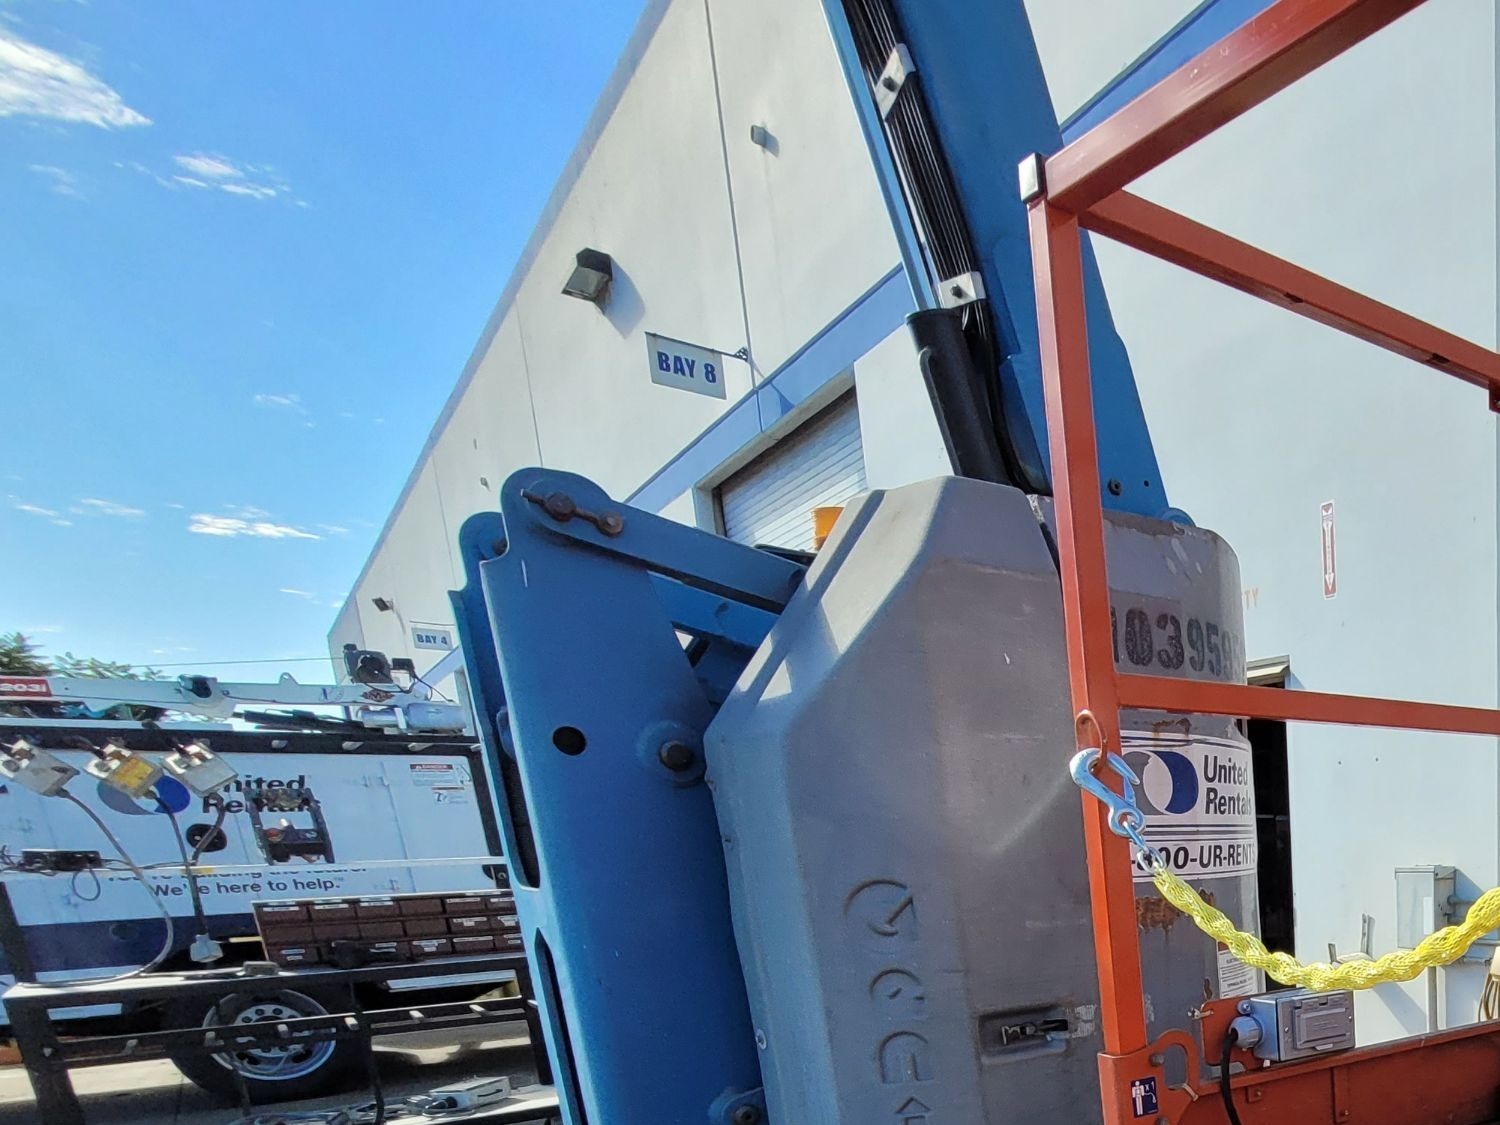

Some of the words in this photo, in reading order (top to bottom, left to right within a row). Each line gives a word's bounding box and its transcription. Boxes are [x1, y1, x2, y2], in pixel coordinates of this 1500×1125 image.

[656, 351, 697, 380] BAY
[702, 356, 718, 385] 8
[416, 633, 437, 645] BAY
[440, 635, 448, 646] 4
[1203, 753, 1249, 786] United
[216, 880, 262, 895] here
[268, 879, 288, 892] to
